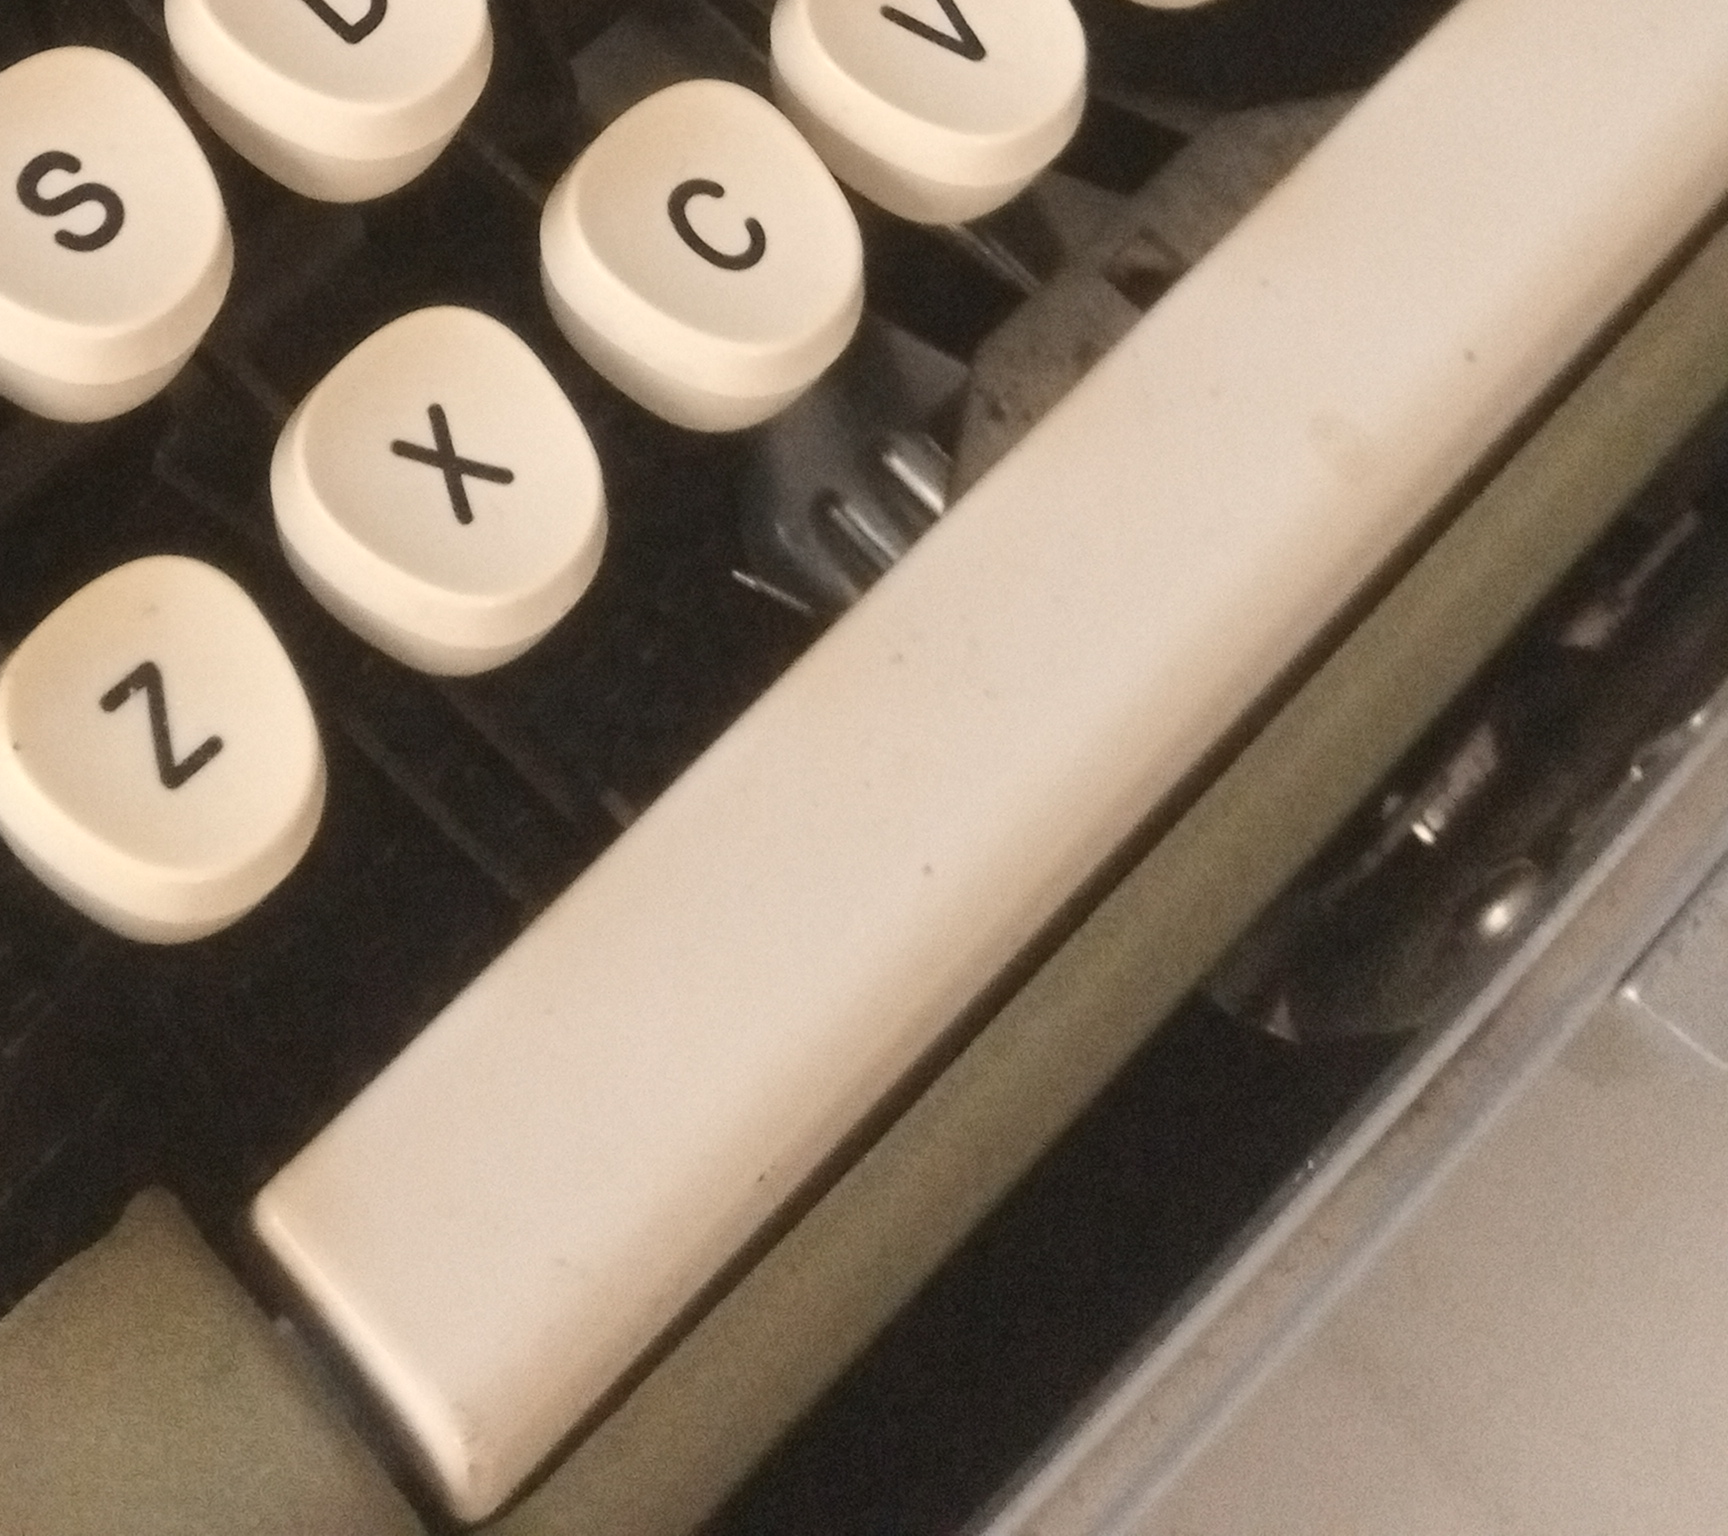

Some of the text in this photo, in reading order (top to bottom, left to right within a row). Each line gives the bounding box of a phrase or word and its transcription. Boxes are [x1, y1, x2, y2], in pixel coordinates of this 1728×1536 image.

[15, 149, 126, 254] S
[666, 177, 767, 272] C
[389, 402, 515, 526] X
[98, 660, 224, 791] Z
